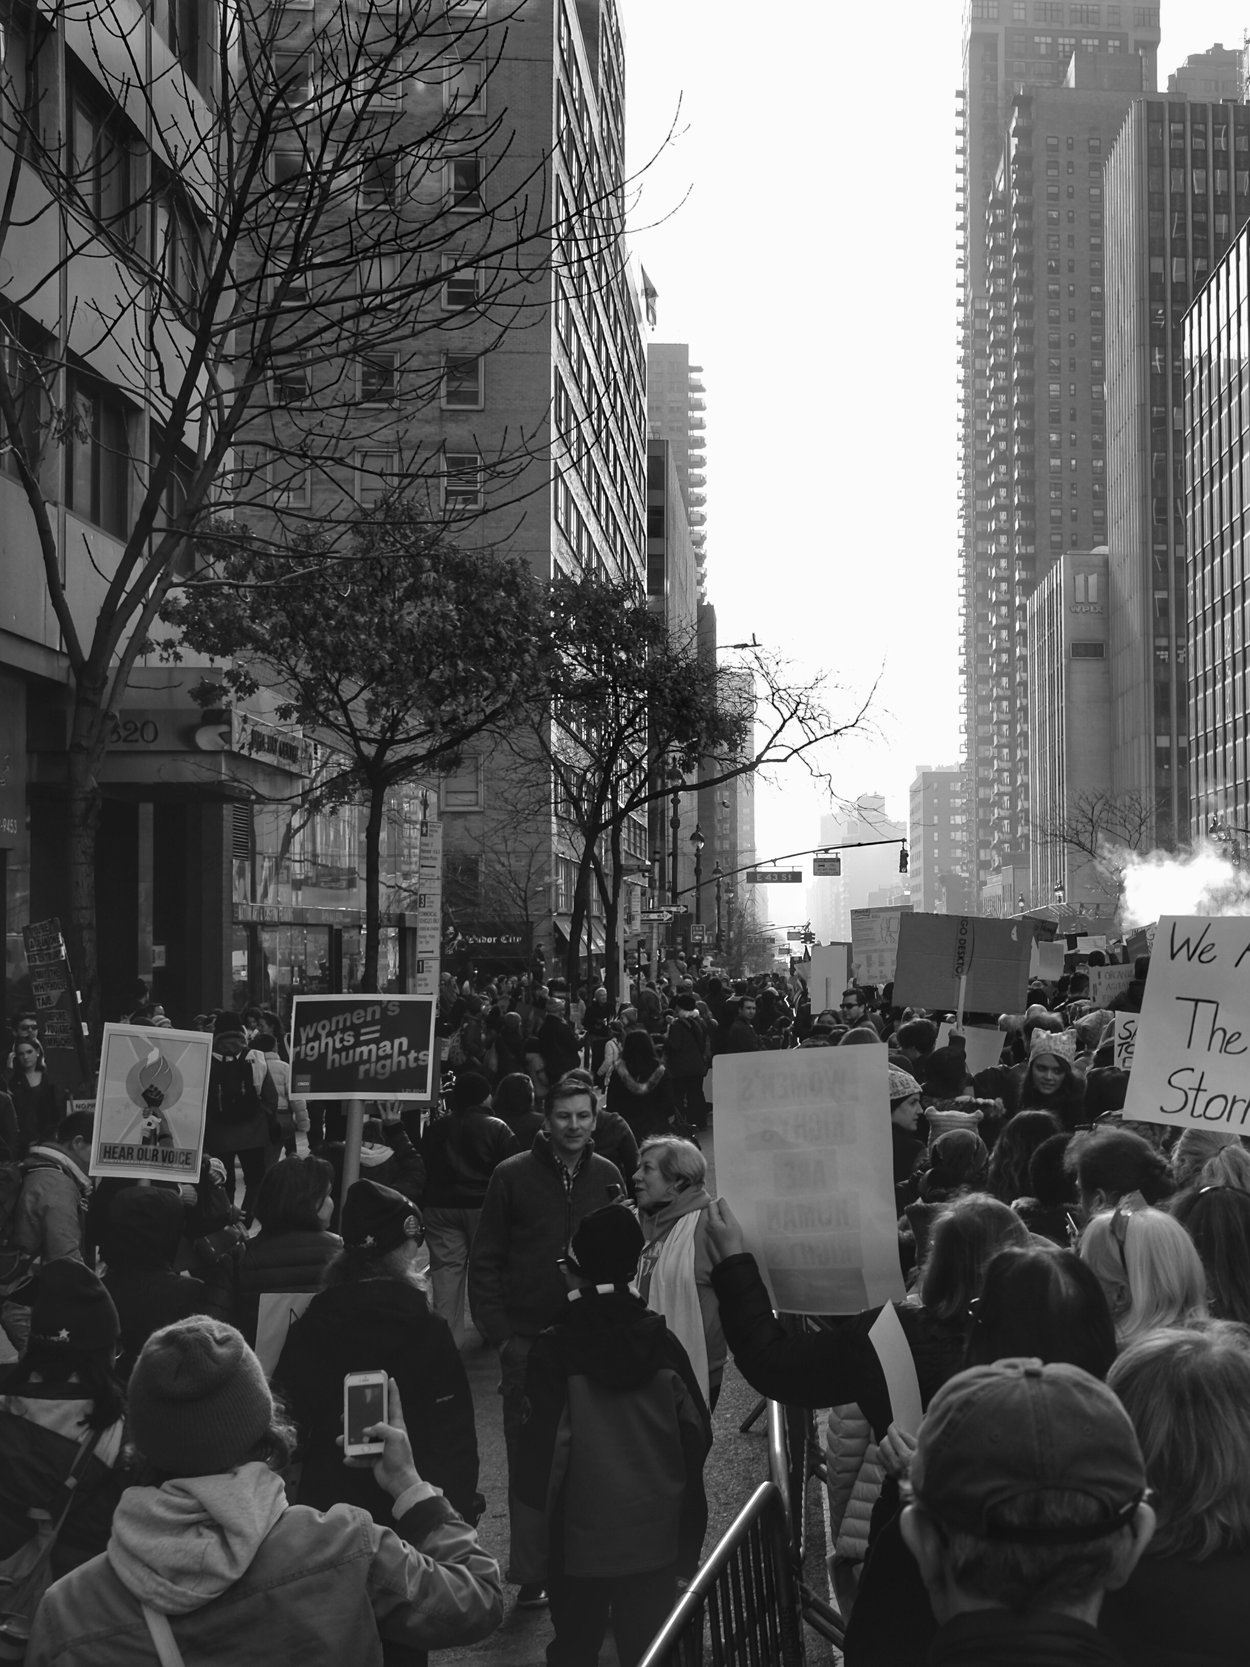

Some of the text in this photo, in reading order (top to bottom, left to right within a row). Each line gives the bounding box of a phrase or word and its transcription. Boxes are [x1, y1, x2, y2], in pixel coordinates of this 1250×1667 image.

[756, 873, 793, 881] E 43 St
[1169, 920, 1218, 965] We
[299, 1000, 401, 1040] women's
[1174, 996, 1249, 1056] The
[291, 1029, 356, 1062] rights
[326, 1036, 409, 1071] human
[357, 1049, 430, 1080] rights
[103, 1145, 134, 1160] HEAR
[136, 1147, 159, 1162] OUR
[161, 1149, 193, 1165] VOICE
